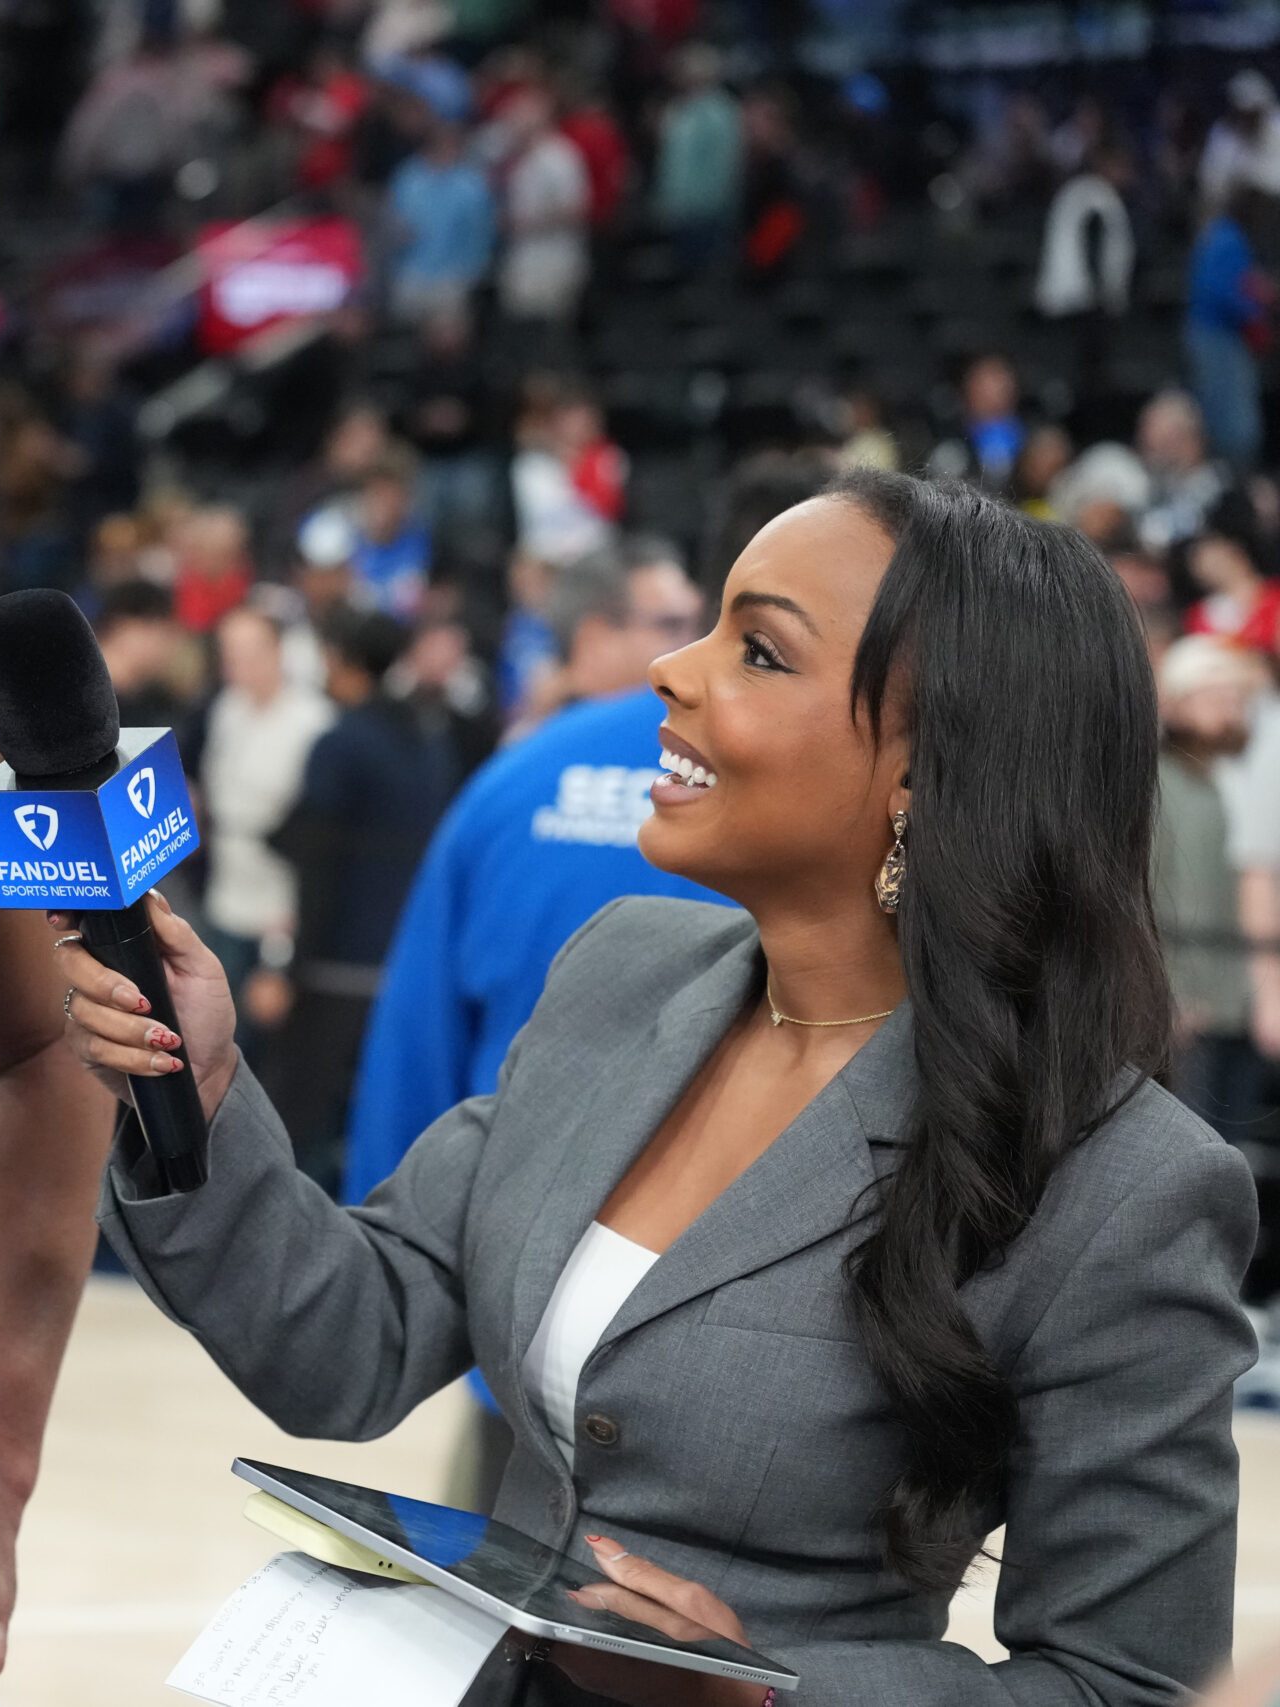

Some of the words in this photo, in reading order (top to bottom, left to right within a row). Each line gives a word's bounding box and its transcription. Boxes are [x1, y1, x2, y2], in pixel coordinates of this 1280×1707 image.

[121, 806, 189, 874] FANDUEL
[127, 858, 156, 890] SPORTS
[156, 829, 193, 866] NETWORK
[1, 884, 49, 898] SPORTS
[50, 885, 111, 898] NETWORK
